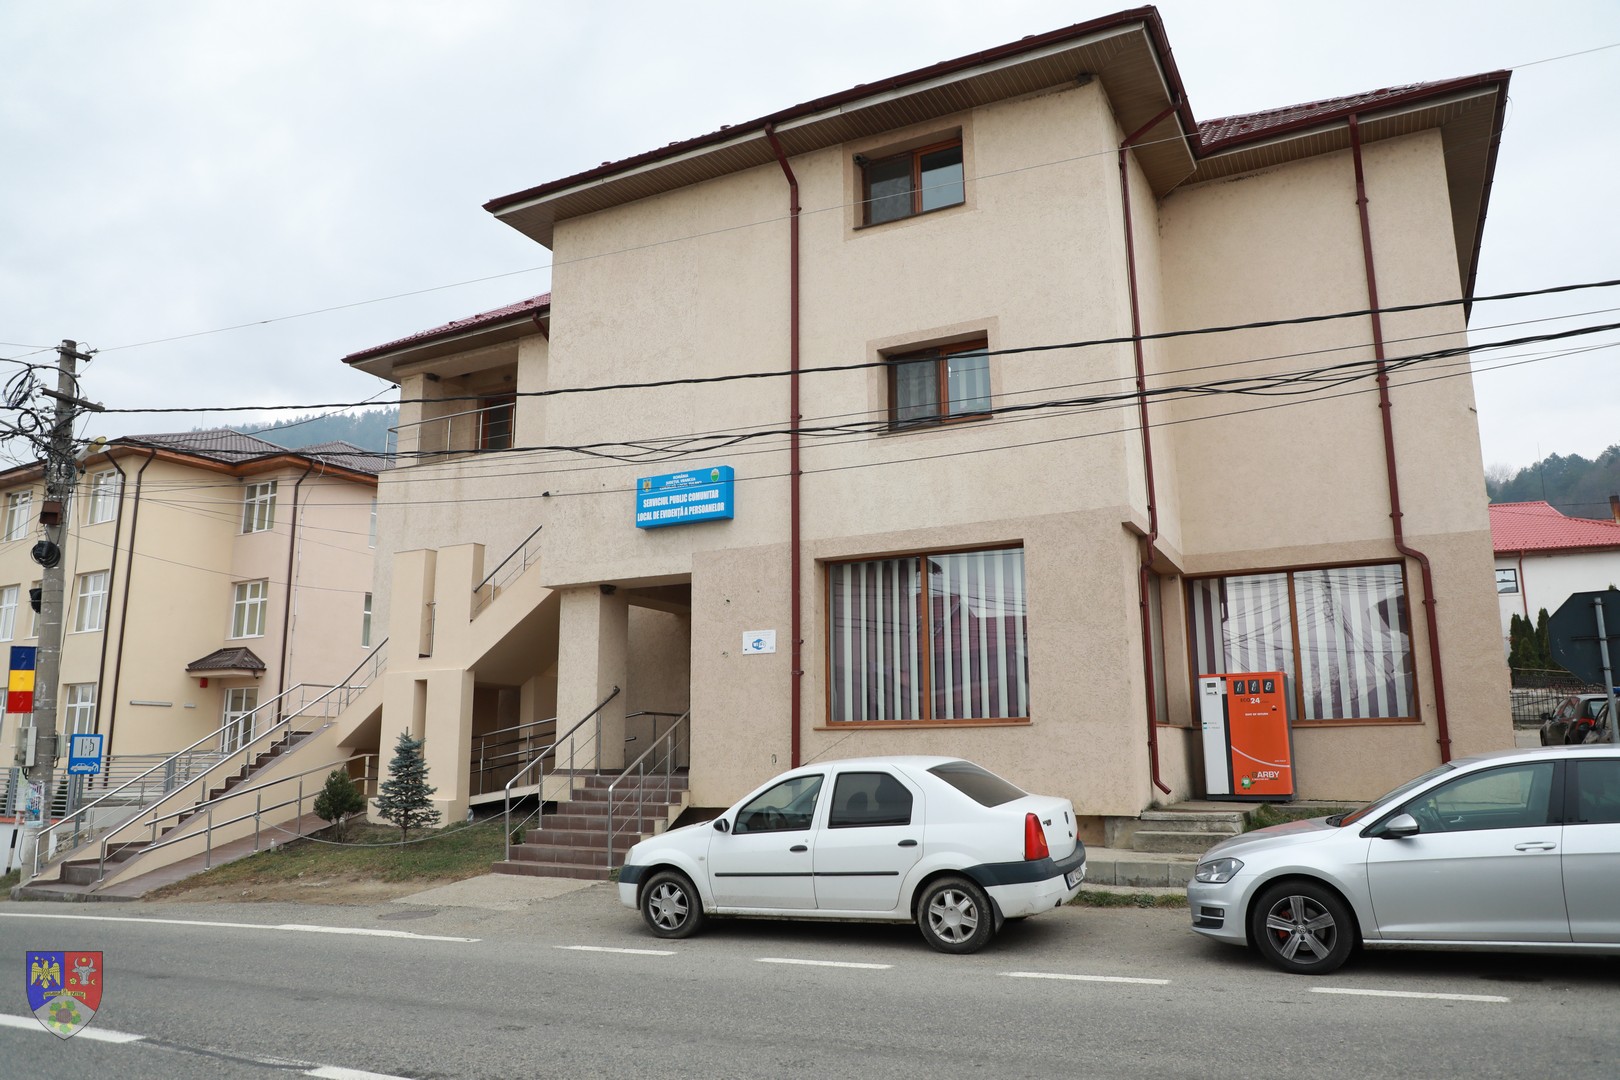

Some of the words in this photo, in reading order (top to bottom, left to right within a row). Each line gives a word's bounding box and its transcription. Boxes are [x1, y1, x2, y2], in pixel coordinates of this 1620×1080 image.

[643, 497, 668, 508] SERVICIUL
[670, 494, 687, 504] PUBLIC
[688, 490, 719, 501] COMUNITAR
[638, 512, 652, 522] LOCAL
[660, 506, 683, 519] EVIDENȚĂ
[689, 502, 724, 514] PERSOANELOR
